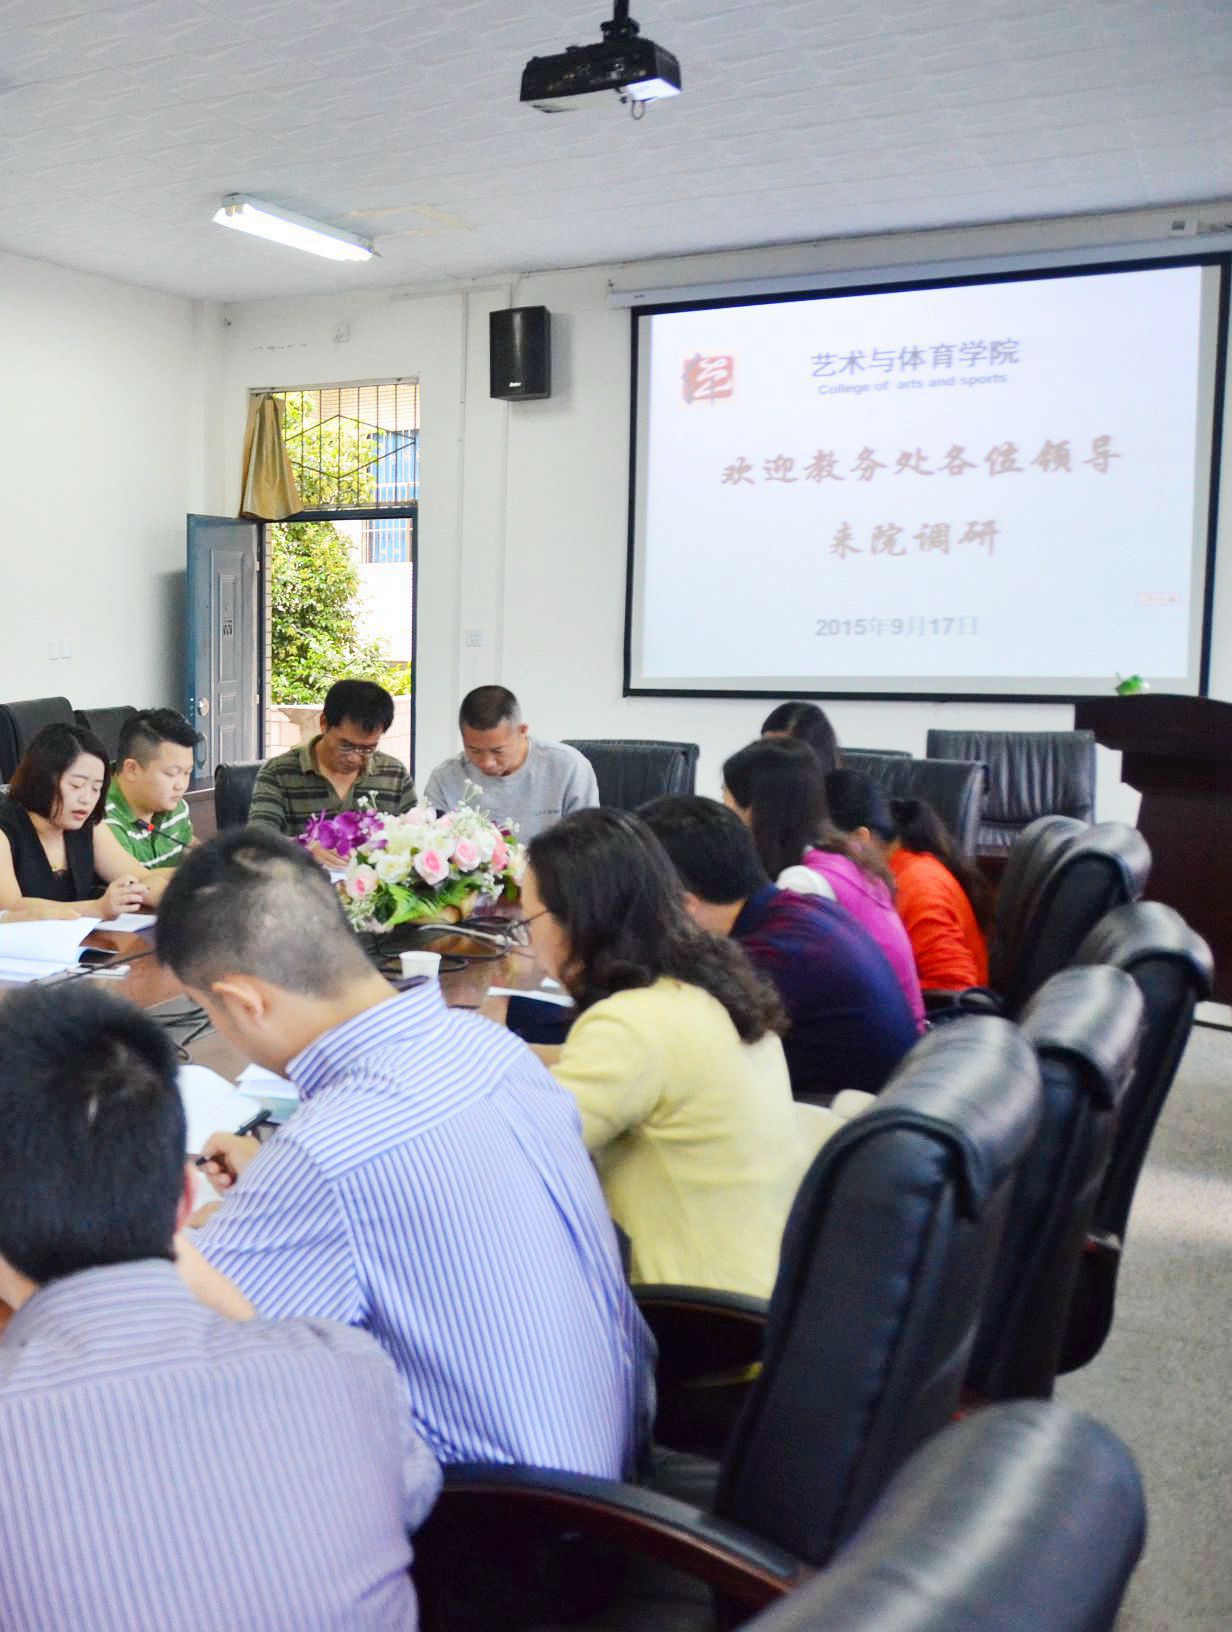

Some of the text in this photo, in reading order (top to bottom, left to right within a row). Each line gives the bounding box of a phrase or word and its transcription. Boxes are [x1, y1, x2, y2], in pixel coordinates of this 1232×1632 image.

[810, 337, 1020, 378] 艺术与体育学院
[818, 373, 1007, 395] College of arts and sports
[720, 434, 1122, 485] 欢迎教务处各位领导
[828, 519, 1002, 560] 来院调研
[815, 615, 979, 637] 2015年9月17日
